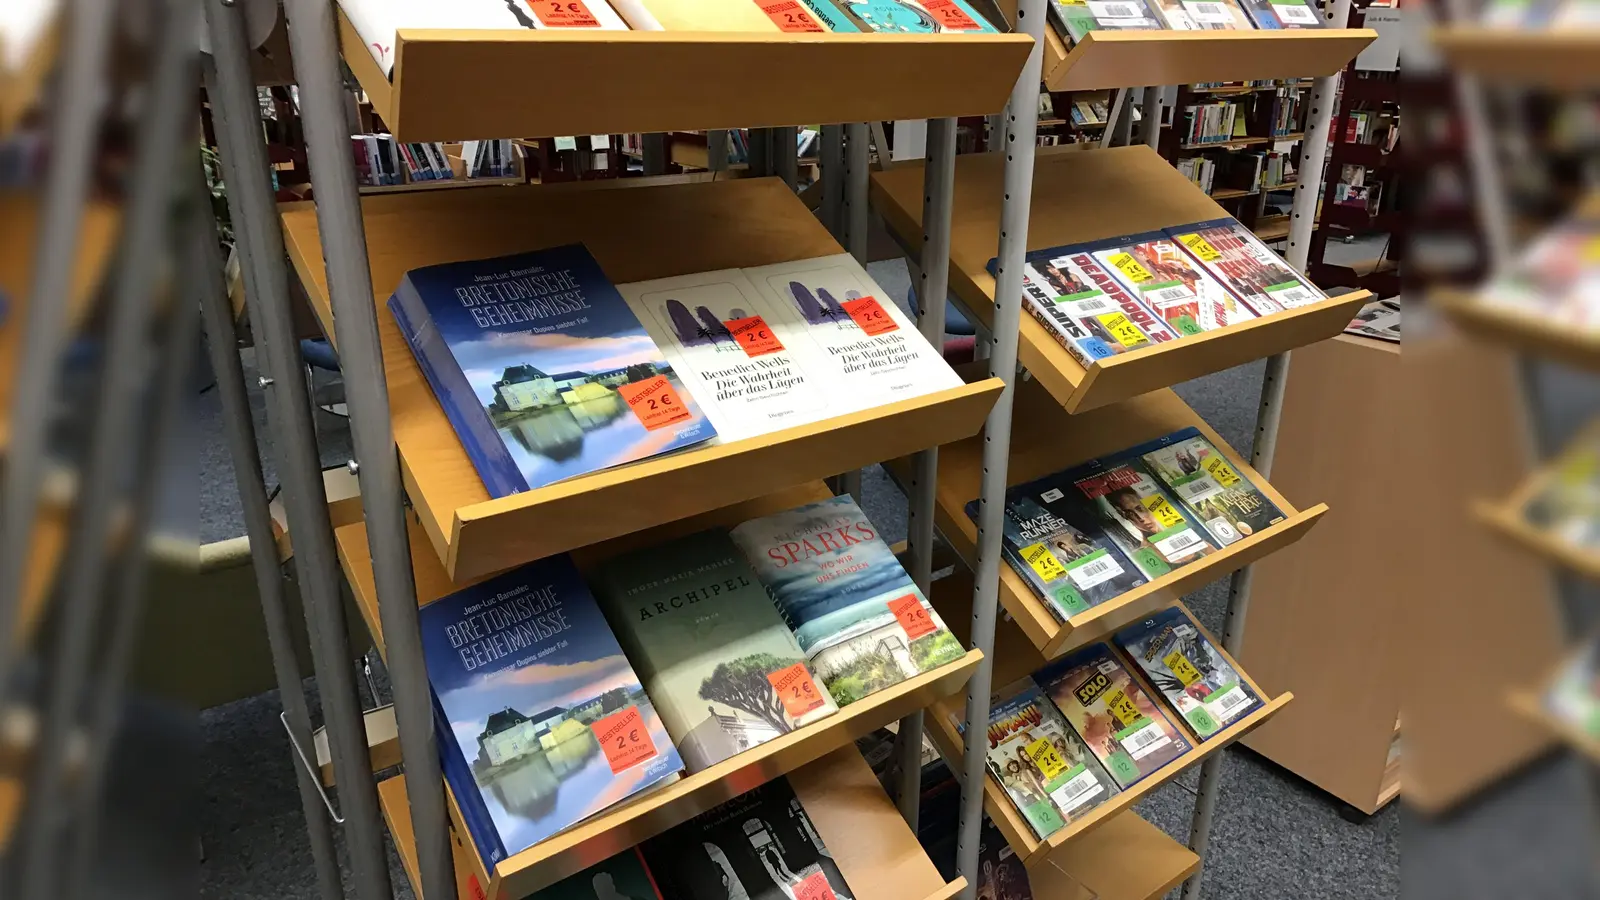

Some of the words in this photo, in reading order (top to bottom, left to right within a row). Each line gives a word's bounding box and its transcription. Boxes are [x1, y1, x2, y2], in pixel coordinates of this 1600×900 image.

[551, 2, 563, 12] 2
[567, 3, 580, 12] €
[941, 9, 952, 18] 2
[953, 9, 962, 18] €
[784, 14, 796, 22] 2
[798, 14, 810, 22] €
[814, 6, 836, 30] Laetitia
[1197, 245, 1204, 253] 2
[474, 270, 510, 282] Jean-Luc
[510, 266, 544, 278] Bannalec
[454, 270, 582, 308] BRETONISCHE
[1071, 254, 1156, 332] DEADPOOL
[1150, 330, 1172, 344] 2
[469, 290, 592, 328] GEHEIMNISSE
[864, 312, 873, 322] 2
[874, 310, 882, 319] €
[1027, 286, 1087, 338] SUPER
[533, 324, 556, 334] Dupins
[556, 320, 577, 330] siebter
[576, 316, 588, 325] Fall
[731, 318, 762, 336] BESTSELLER
[1119, 327, 1127, 336] 2
[1126, 326, 1135, 335] €
[1184, 324, 1197, 334] 12
[746, 332, 756, 342] 2
[758, 330, 768, 340] €
[828, 340, 876, 356] Benedict
[876, 334, 905, 348] Wells
[842, 352, 860, 364] Die
[861, 344, 907, 360] Wahrheit
[1093, 346, 1107, 356] 16
[701, 362, 756, 380] Benedict
[756, 356, 790, 369] Wells
[844, 362, 867, 374] über
[868, 358, 887, 370] das
[888, 352, 919, 365] Lügen
[716, 377, 738, 390] Die
[738, 368, 792, 386] Wahrheit
[628, 380, 667, 406] BESTSELLER
[716, 387, 744, 402] über
[746, 382, 768, 394] das
[768, 376, 804, 390] Lügen
[647, 399, 658, 410] 2
[660, 394, 672, 406] €
[1159, 509, 1166, 518] 2
[1165, 506, 1173, 515] €
[1234, 494, 1262, 514] HEXE
[774, 516, 850, 543] NICHOLAS
[1020, 512, 1054, 530] MAZE
[1020, 518, 1068, 540] RUNNER
[768, 520, 875, 568] SPARKS
[819, 562, 834, 570] WO
[836, 554, 854, 565] WIR
[1040, 560, 1048, 570] 2
[1046, 558, 1054, 566] €
[1147, 558, 1159, 568] 12
[816, 573, 836, 584] UNS
[836, 562, 870, 577] FINDEN
[464, 598, 496, 616] Jean-Luc
[496, 584, 530, 601] Bannalec
[639, 576, 750, 622] ARCHIPEL
[1063, 594, 1076, 606] 12
[444, 584, 562, 648] BRETONISCHE
[906, 612, 916, 622] 2
[916, 609, 924, 618] €
[458, 608, 572, 672] GEHEIMNISSE
[516, 654, 538, 667] Dupins
[538, 646, 557, 659] siebter
[556, 640, 569, 650] Fall
[1178, 666, 1184, 674] 2
[1182, 662, 1190, 670] €
[774, 666, 804, 692] BESTSELLER
[1079, 674, 1108, 703] SOLO
[792, 686, 801, 698] 2
[802, 681, 812, 694] €
[1120, 704, 1127, 713] 2
[1126, 701, 1132, 710] €
[598, 712, 637, 744] BESTSELLER
[988, 704, 1043, 750] JUMANJI
[1197, 716, 1208, 726] 12
[616, 736, 626, 750] 2
[629, 729, 640, 742] €
[1044, 756, 1052, 766] 2
[1050, 752, 1057, 762] €
[1117, 762, 1130, 773] 12
[1038, 812, 1052, 824] 12
